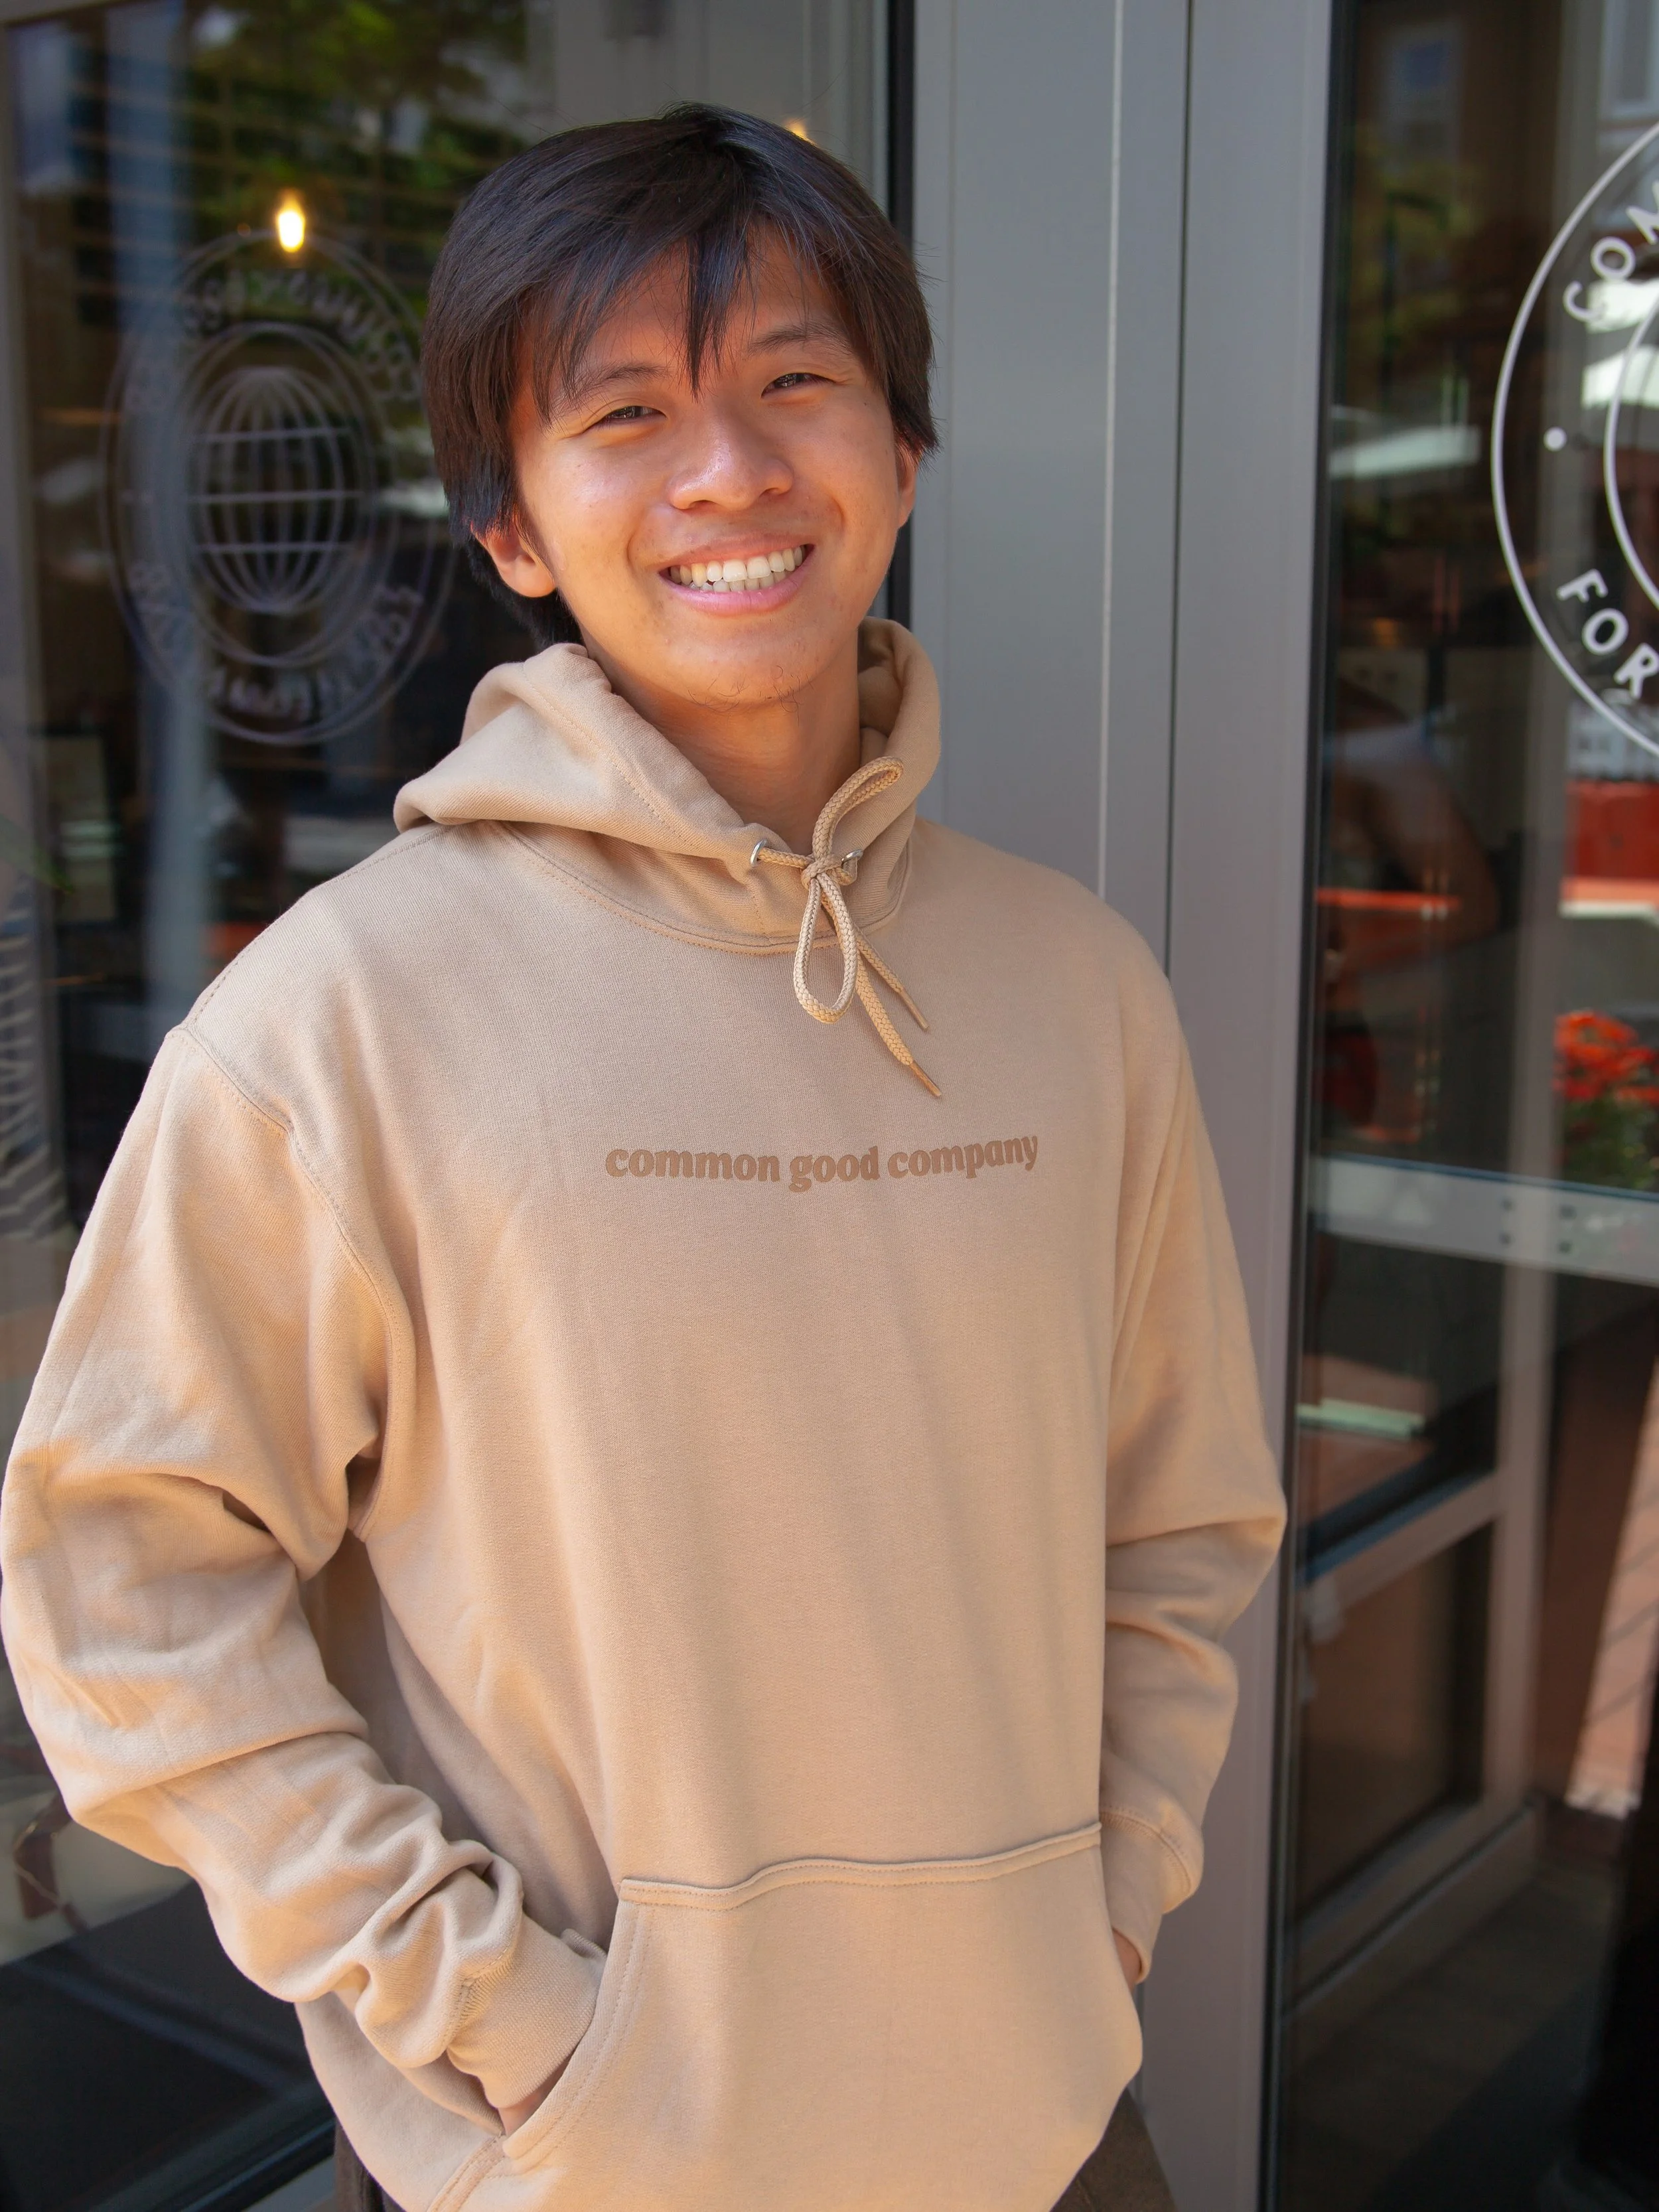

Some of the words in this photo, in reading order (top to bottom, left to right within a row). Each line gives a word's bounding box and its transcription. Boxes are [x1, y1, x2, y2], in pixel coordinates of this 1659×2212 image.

[1557, 569, 1659, 700] FOR
[605, 1149, 780, 1182] common
[788, 1145, 880, 1193] good
[887, 1136, 1038, 1179] company
